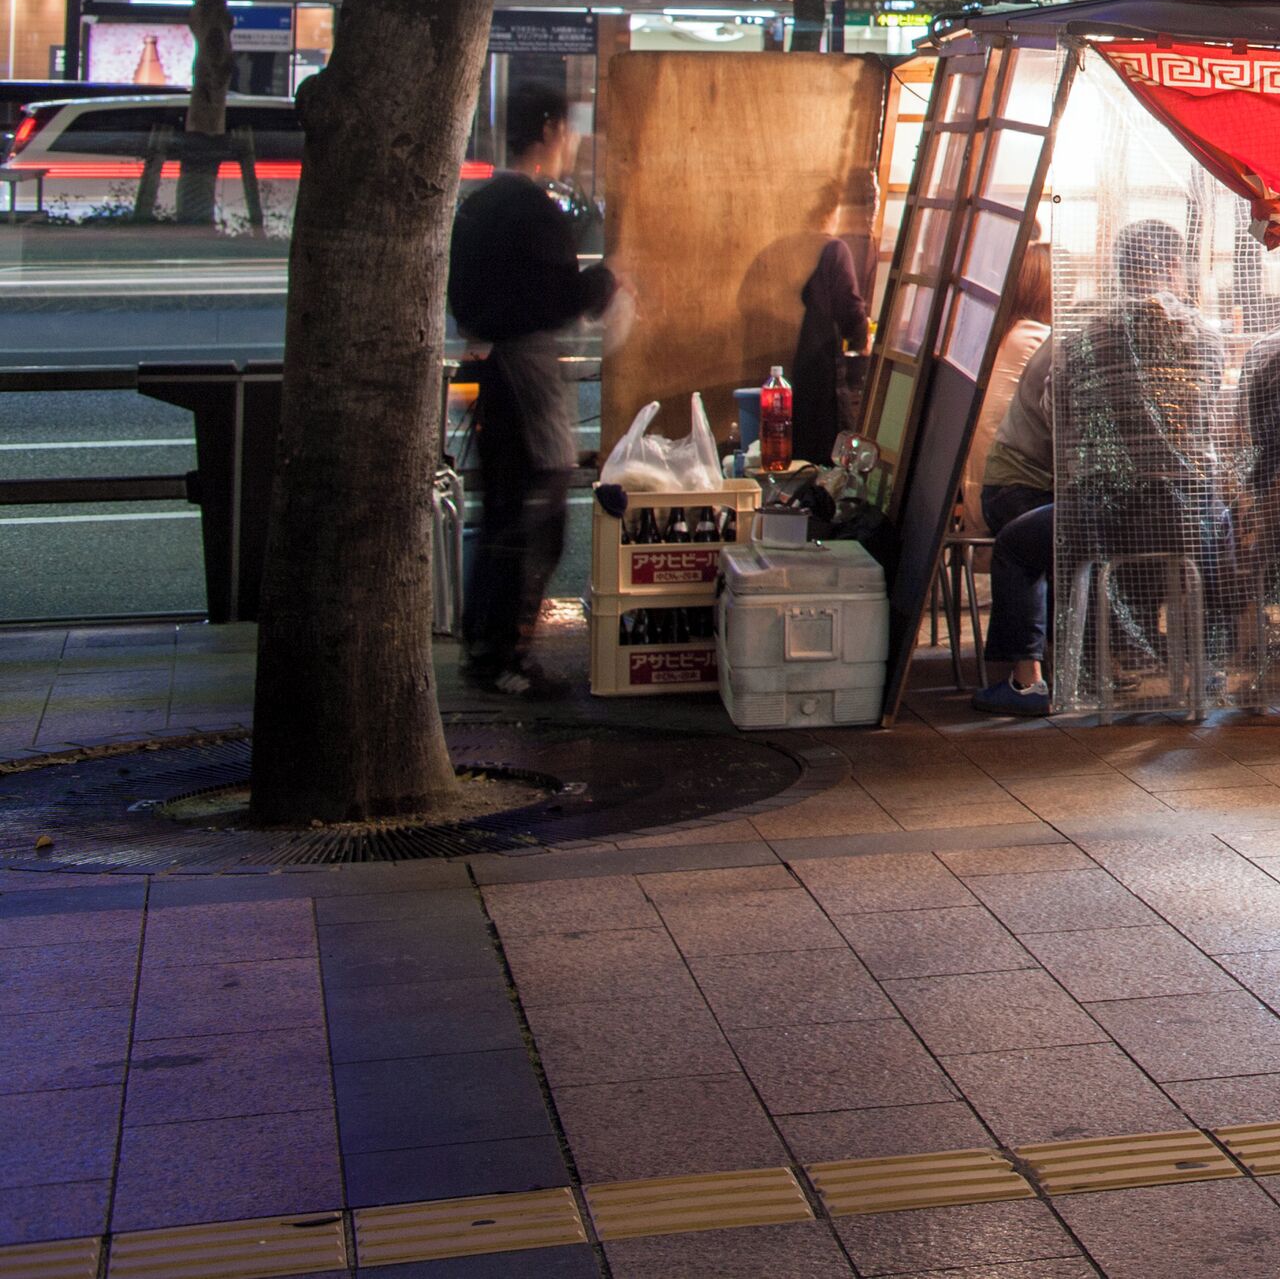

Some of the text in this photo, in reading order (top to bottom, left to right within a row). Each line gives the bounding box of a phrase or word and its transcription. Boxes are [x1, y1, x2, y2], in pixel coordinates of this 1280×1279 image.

[633, 552, 719, 570] アサヒビール
[631, 651, 718, 670] アサヒビール
